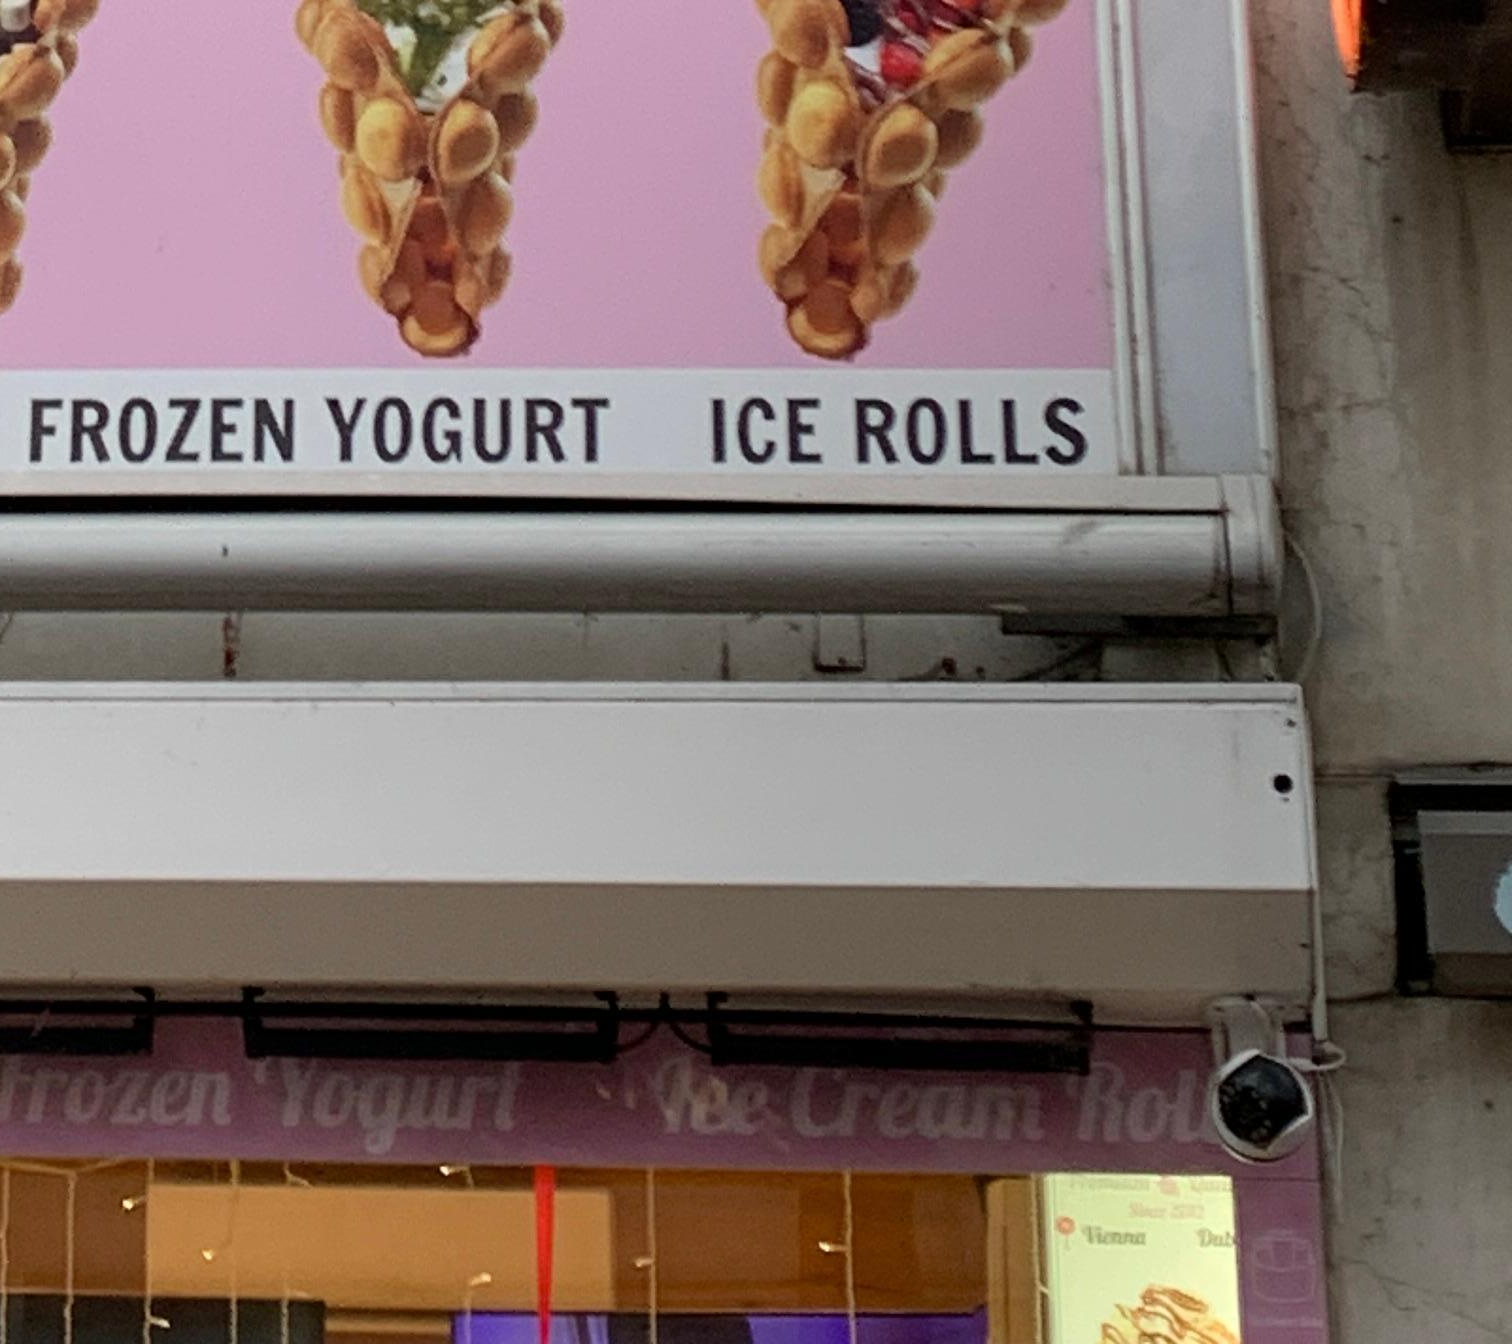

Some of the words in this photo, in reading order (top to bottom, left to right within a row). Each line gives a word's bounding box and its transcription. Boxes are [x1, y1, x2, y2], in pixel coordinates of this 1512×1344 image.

[28, 397, 295, 463] FROZEN
[326, 396, 610, 463] YOGURT
[710, 397, 822, 464] ICE
[854, 397, 1089, 466] ROLLS
[254, 1055, 520, 1154] Yogurt
[793, 1064, 1045, 1140] Cream
[1082, 1226, 1147, 1246] Vienna
[1194, 1227, 1237, 1249] Dub
